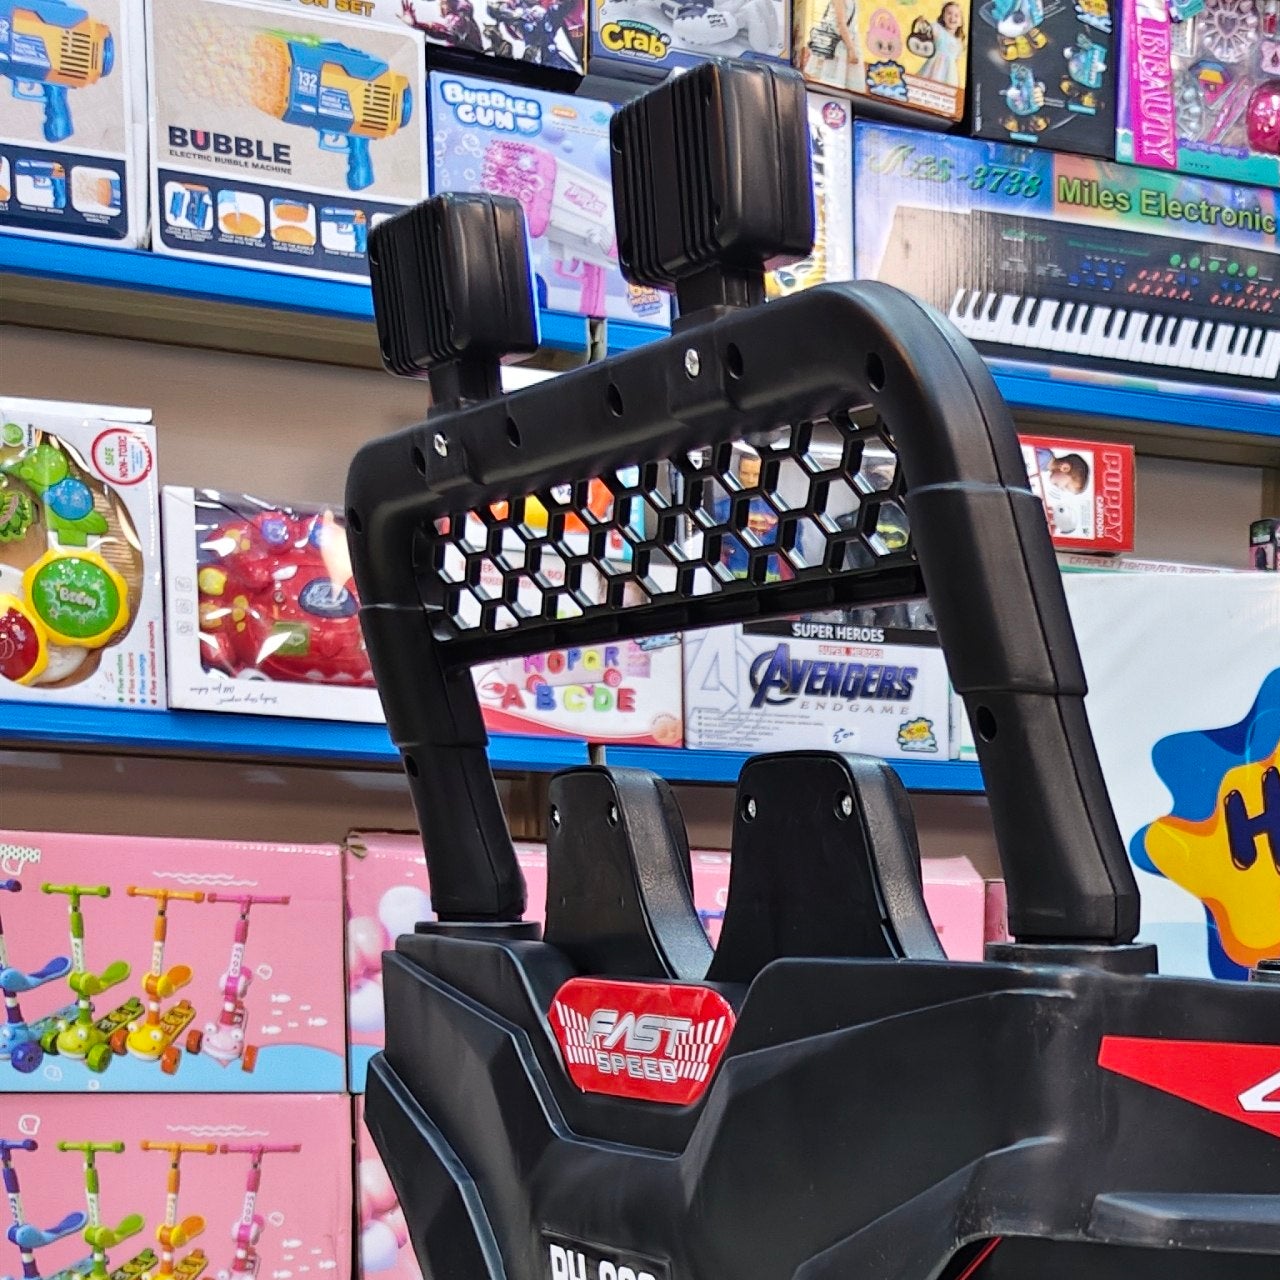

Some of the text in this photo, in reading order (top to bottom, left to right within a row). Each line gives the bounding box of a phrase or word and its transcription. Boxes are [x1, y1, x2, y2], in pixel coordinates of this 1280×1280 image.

[601, 22, 667, 59] Crab
[443, 81, 540, 118] BUBBLES
[1137, 27, 1175, 165] BEAUTY
[456, 104, 515, 131] GUN
[168, 125, 291, 165] BUBBLE
[169, 150, 292, 176] ELECTRIC BUBBLE MACHINE
[1058, 176, 1131, 211] Miles
[1141, 189, 1276, 234] Electronic
[104, 447, 115, 466] SAFE
[117, 435, 128, 479] NON-TOXIC
[1096, 495, 1104, 538] CARTOON
[1102, 452, 1122, 543] PUPPY
[792, 622, 885, 643] SUPER HEROES
[751, 642, 919, 708] AVENGERS
[800, 701, 911, 715] ENDGAME
[585, 1008, 693, 1058] FAST
[595, 1051, 679, 1084] SPEED
